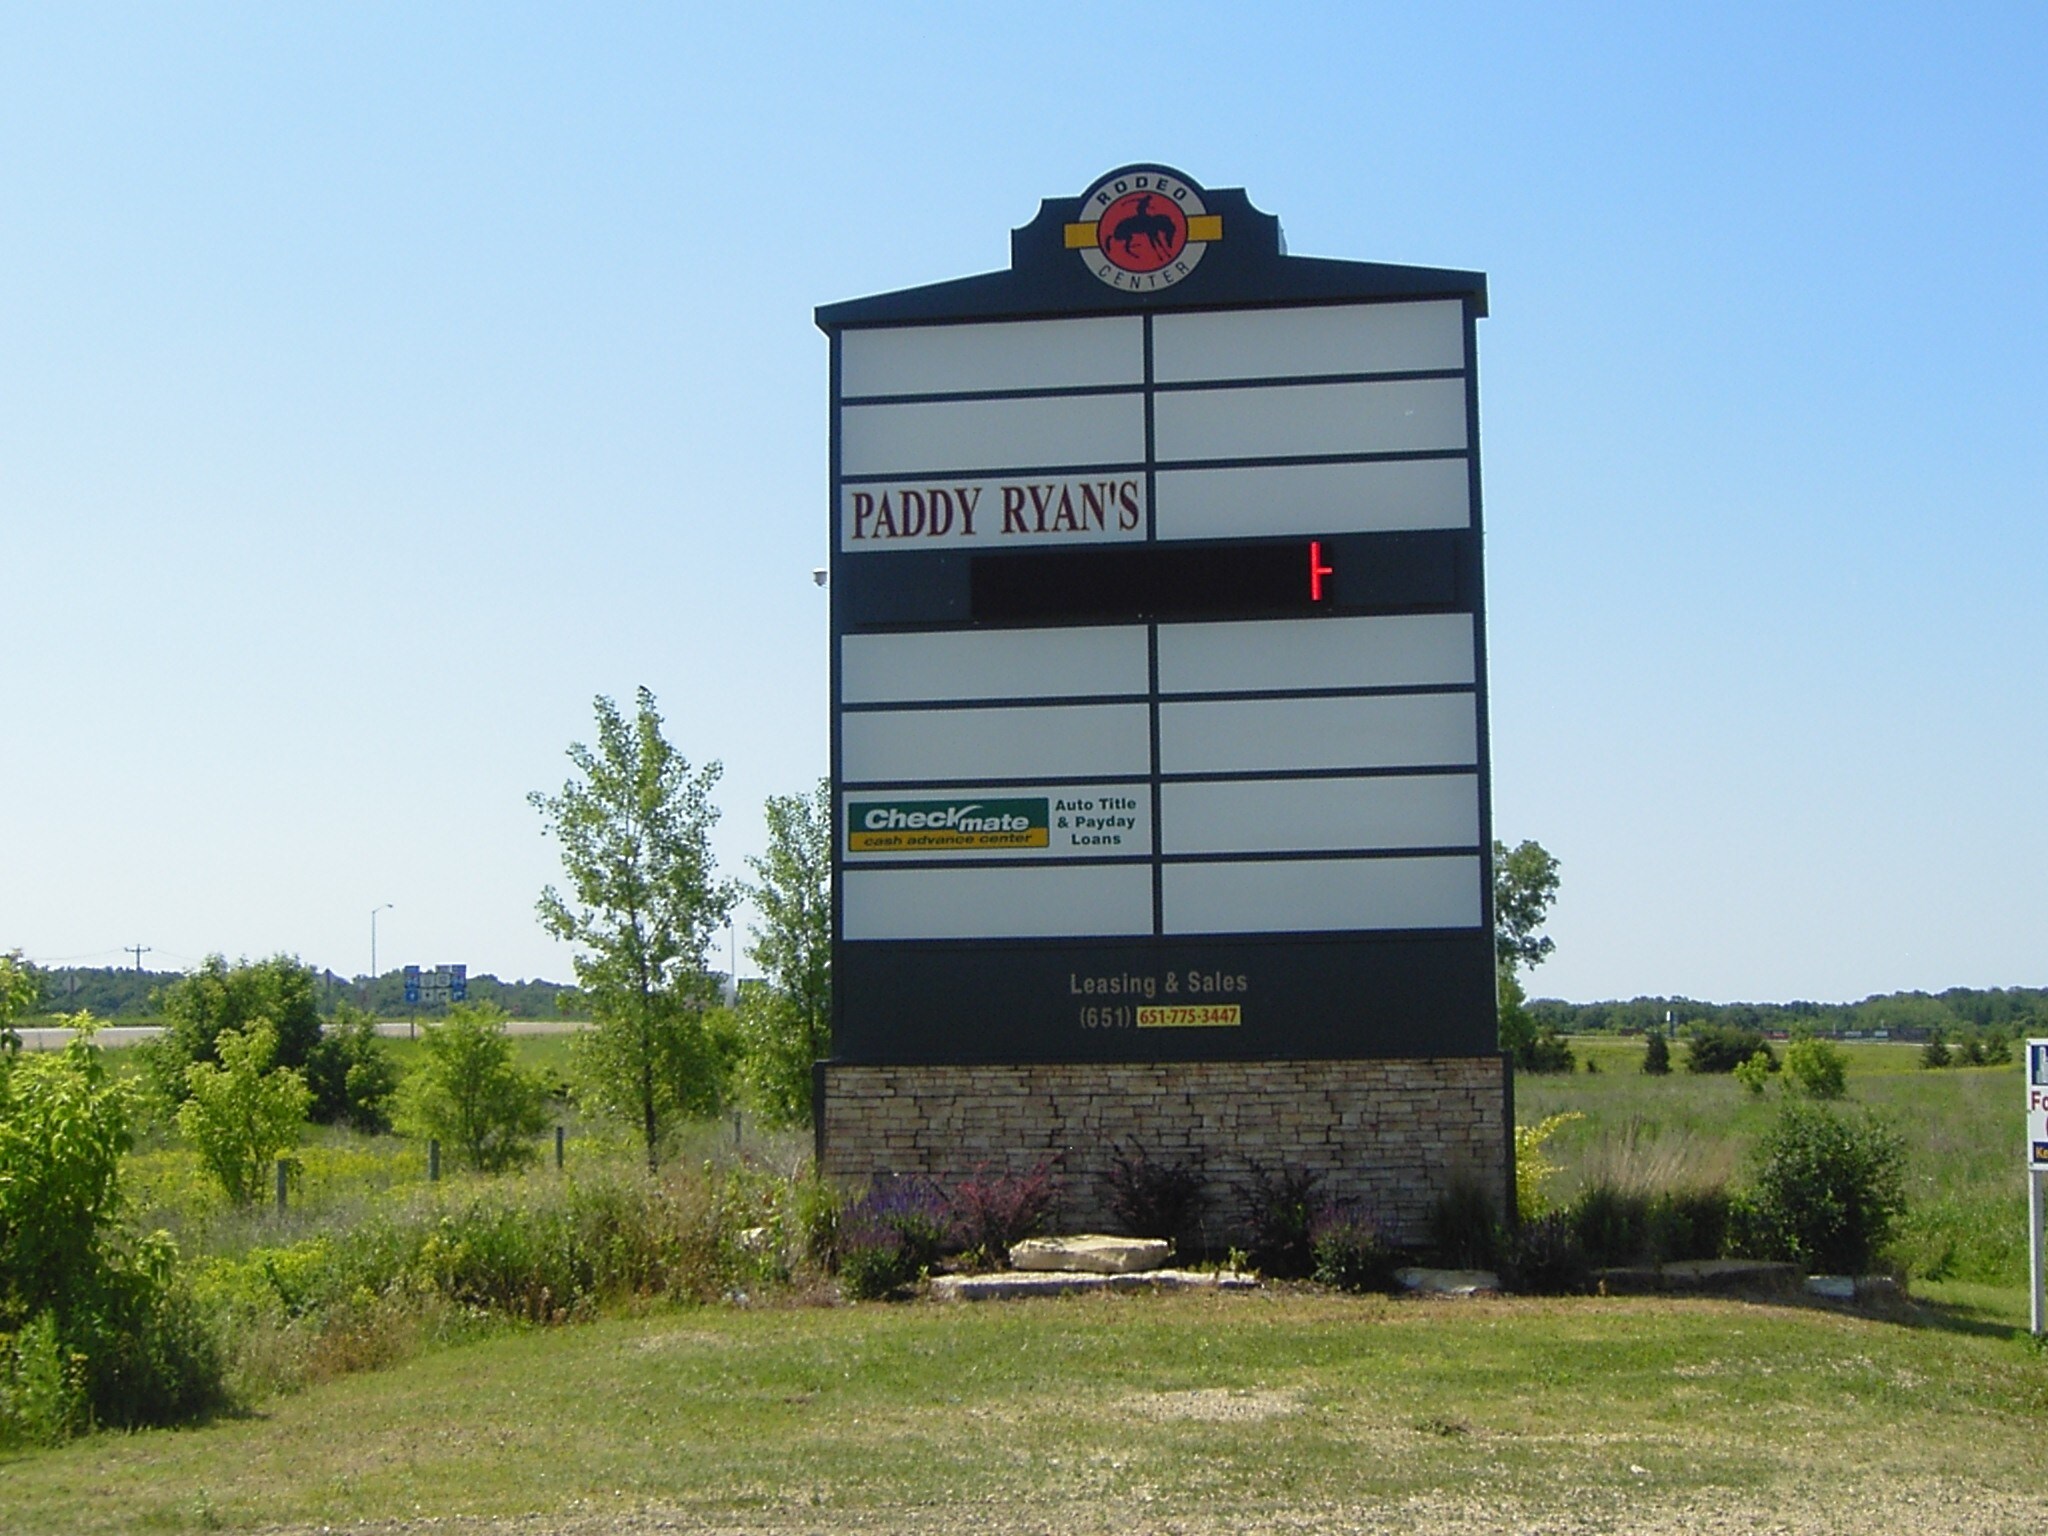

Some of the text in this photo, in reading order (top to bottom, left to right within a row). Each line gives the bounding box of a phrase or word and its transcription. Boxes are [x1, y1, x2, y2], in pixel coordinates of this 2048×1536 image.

[1096, 176, 1186, 206] RODEO
[1098, 261, 1190, 289] CENTER
[851, 480, 1139, 540] PADDY RYAN'S
[1056, 798, 1136, 811] Auto Title
[1057, 815, 1135, 830] & Payday
[864, 832, 1032, 846] cash advance center
[1071, 834, 1121, 845] Loans
[1070, 971, 1248, 998] Leasing & Sales
[1080, 1006, 1131, 1029] (651)
